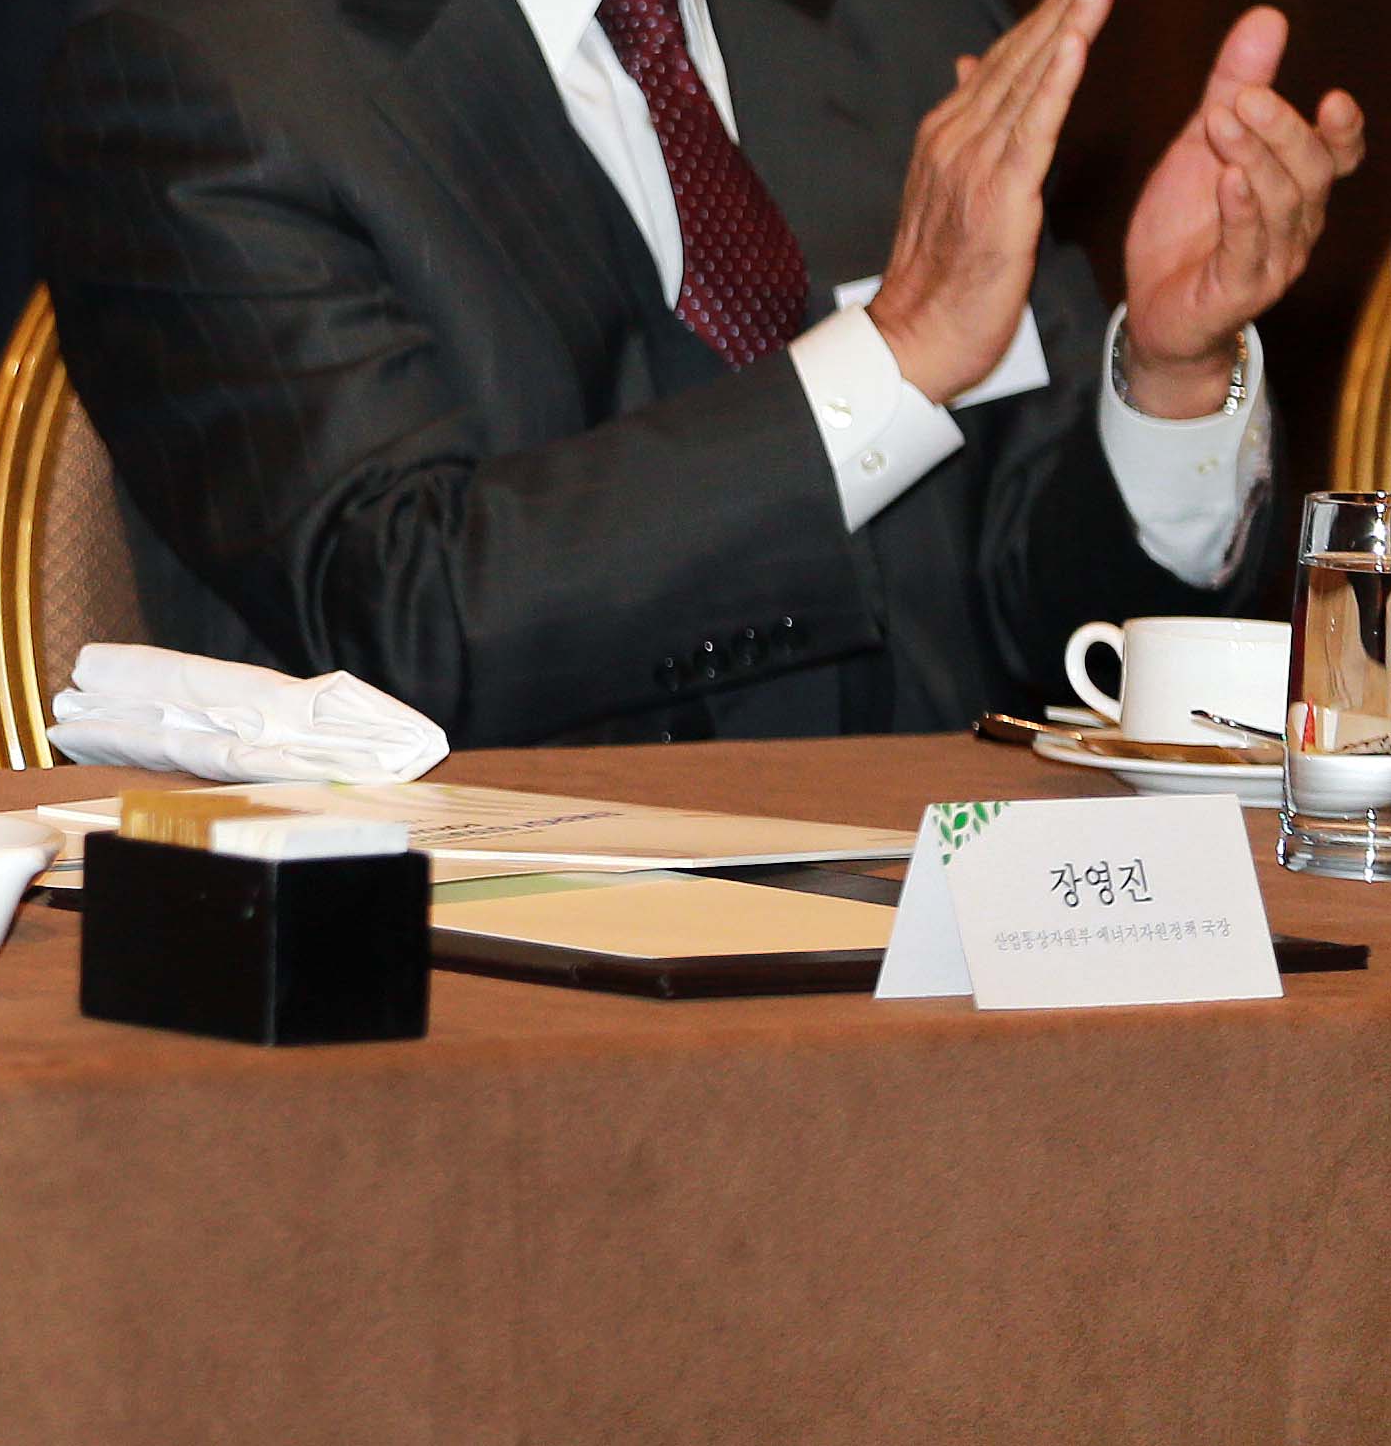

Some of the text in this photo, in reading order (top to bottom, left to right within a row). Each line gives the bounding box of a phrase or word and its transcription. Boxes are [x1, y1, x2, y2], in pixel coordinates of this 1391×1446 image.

[1050, 858, 1153, 907] 장영진
[994, 927, 1092, 950] 산업통상자원부
[1202, 917, 1231, 938] 국장
